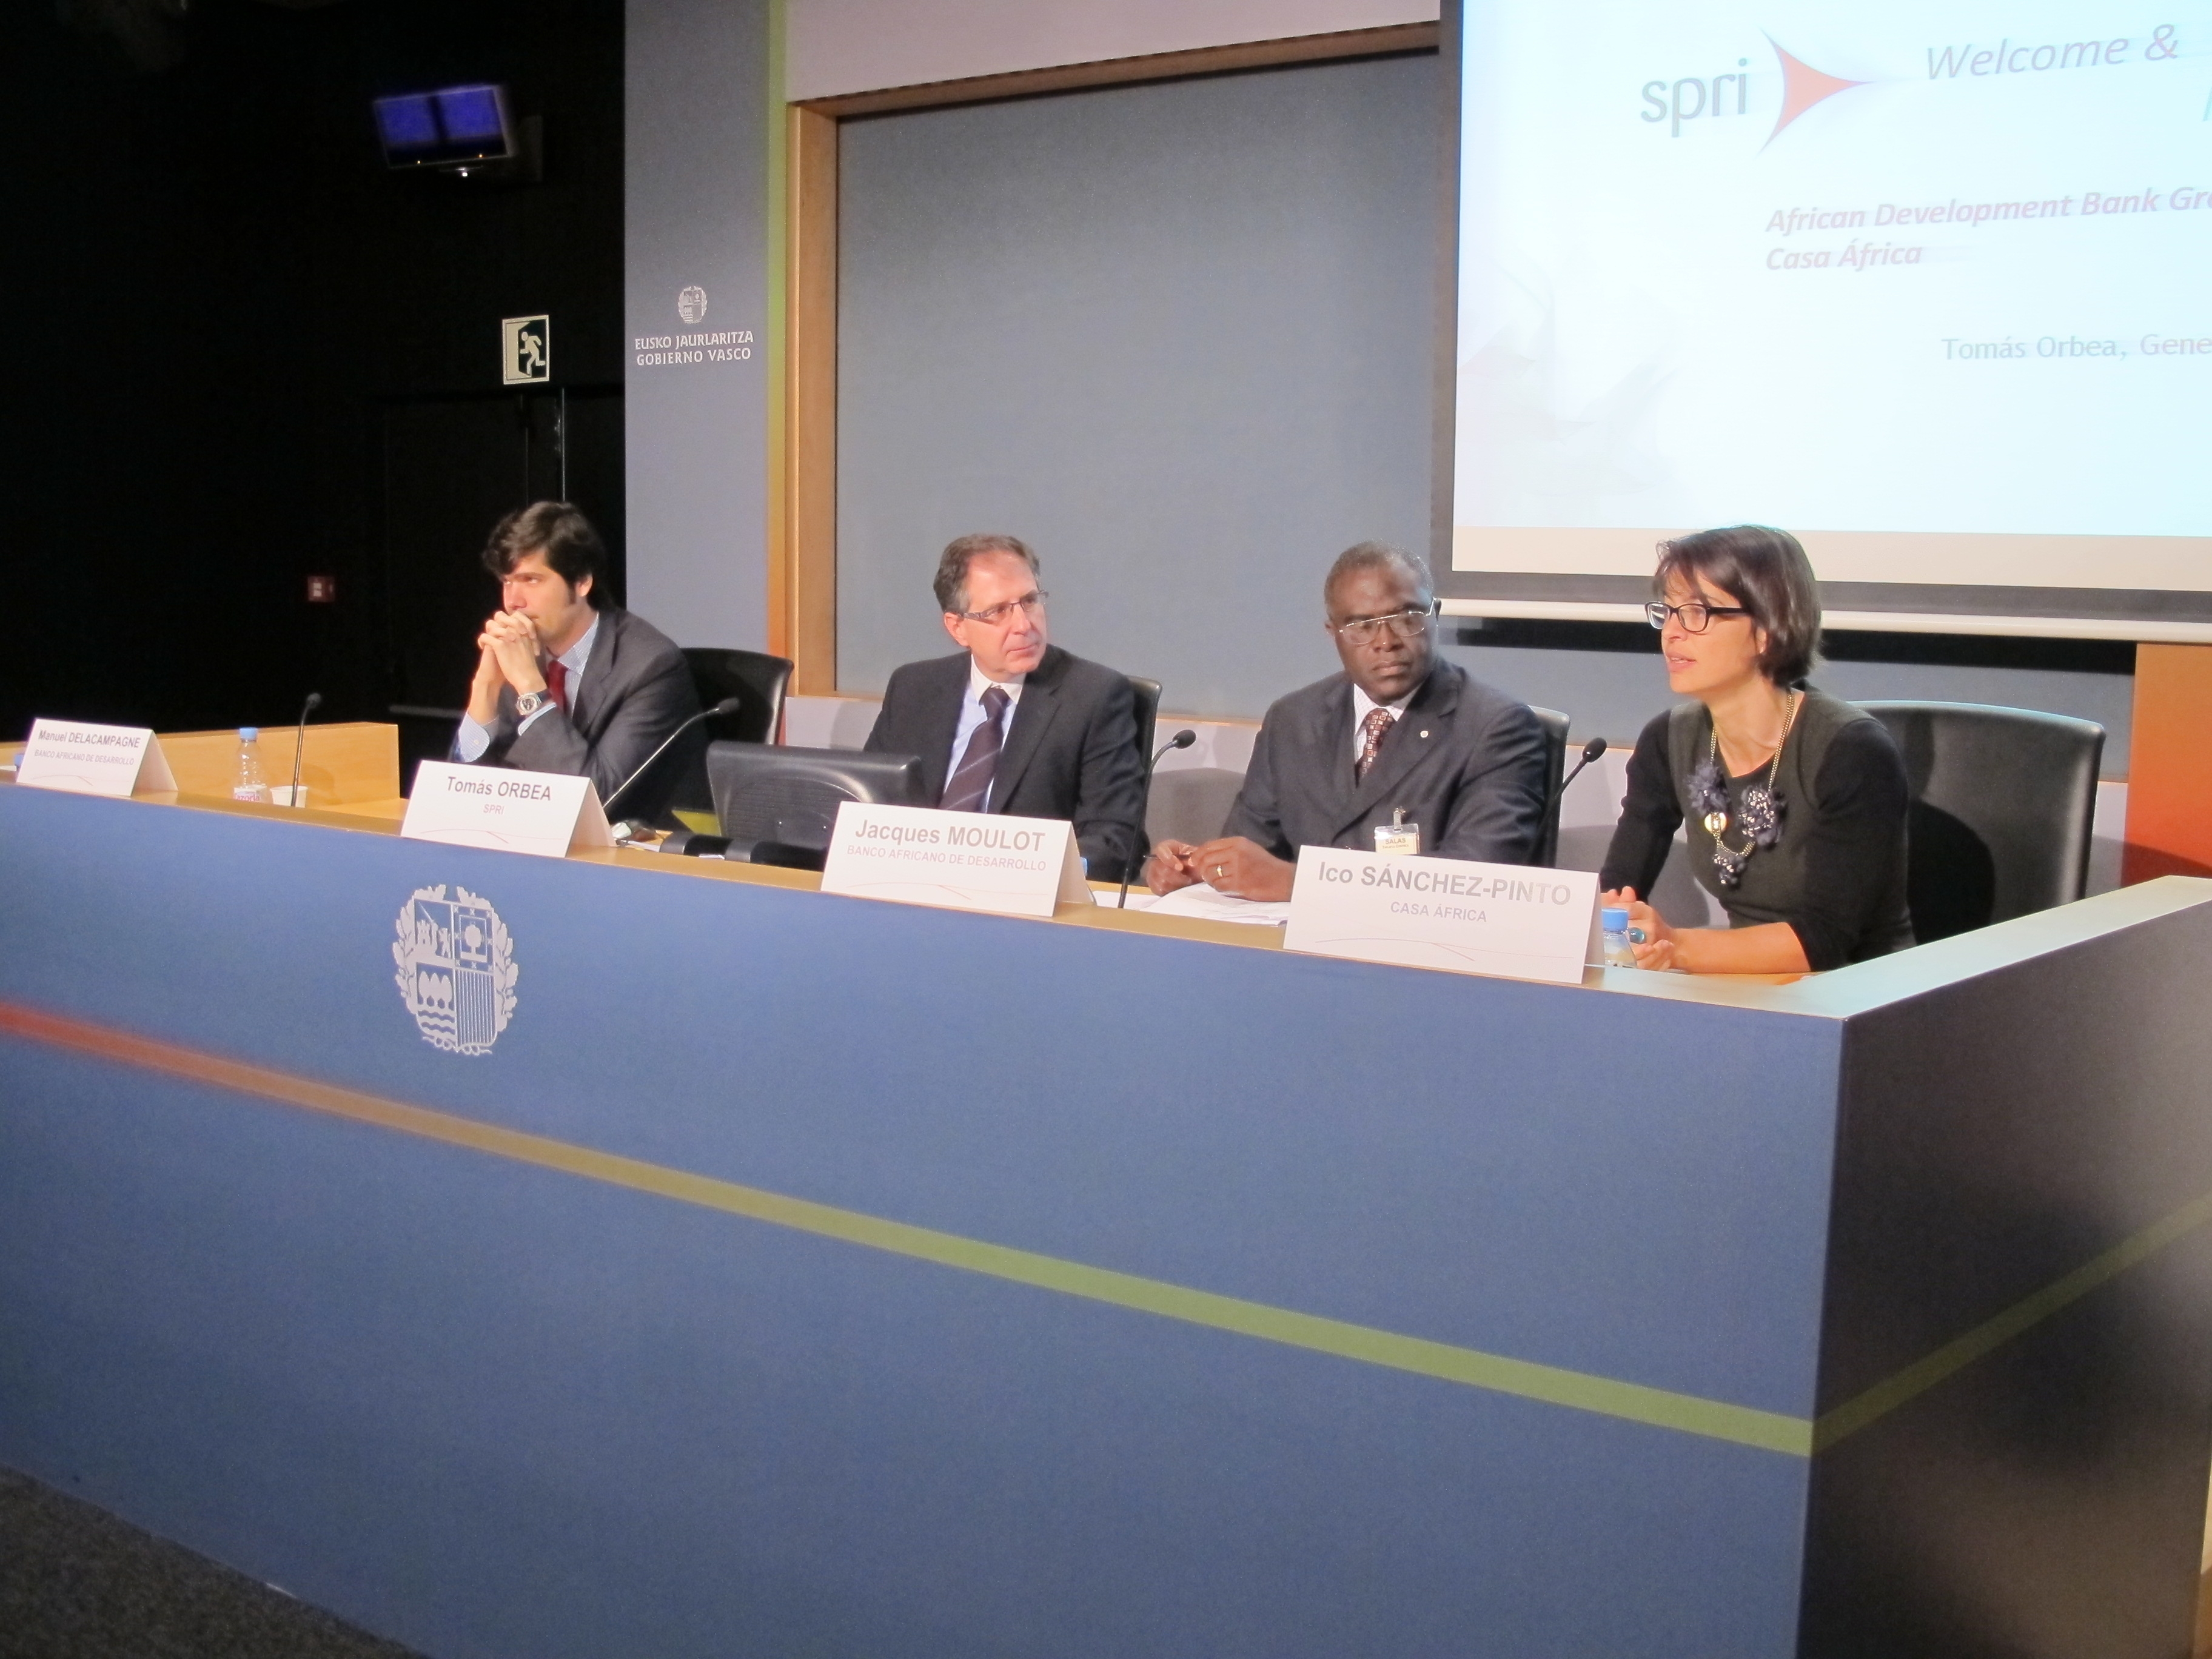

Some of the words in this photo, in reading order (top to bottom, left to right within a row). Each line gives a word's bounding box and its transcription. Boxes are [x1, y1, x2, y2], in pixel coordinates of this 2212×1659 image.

[1926, 36, 2129, 79] Welcome
[2145, 24, 2179, 61] &
[1640, 57, 1749, 138] spri
[1765, 209, 1866, 235] African
[1874, 194, 2072, 227] Development
[2080, 187, 2160, 216] Bank
[1766, 246, 1831, 271] Casa
[1838, 238, 1923, 272] África
[635, 336, 671, 350] EUSKO
[675, 330, 754, 350] JAURLARITZA
[1942, 336, 2026, 361] Tomás
[2036, 336, 2127, 361] Orbea,
[637, 350, 703, 366] GOBIERNO
[708, 347, 751, 361] VASCO
[38, 729, 68, 742] Manuel
[68, 732, 141, 748] DELACAMPAGNE
[34, 749, 56, 758] BANCO
[56, 752, 85, 762] AFRICANO
[95, 756, 135, 766] DESARROLLO
[447, 776, 493, 795] Tomás
[497, 781, 551, 801] ORBEA
[483, 803, 504, 816] SPRI
[855, 819, 940, 846] Jacques
[947, 826, 1045, 851] MOULOT
[847, 845, 886, 859] BANCO
[888, 849, 946, 863] AFRICANO
[949, 854, 965, 865] DE
[967, 856, 1047, 872] DESARROLLO
[1318, 861, 1353, 883] Ico
[1360, 863, 1572, 906] SÁNCHEZ-PINTO
[1390, 901, 1430, 916] CASA
[1433, 904, 1487, 923] ÁFRICA
